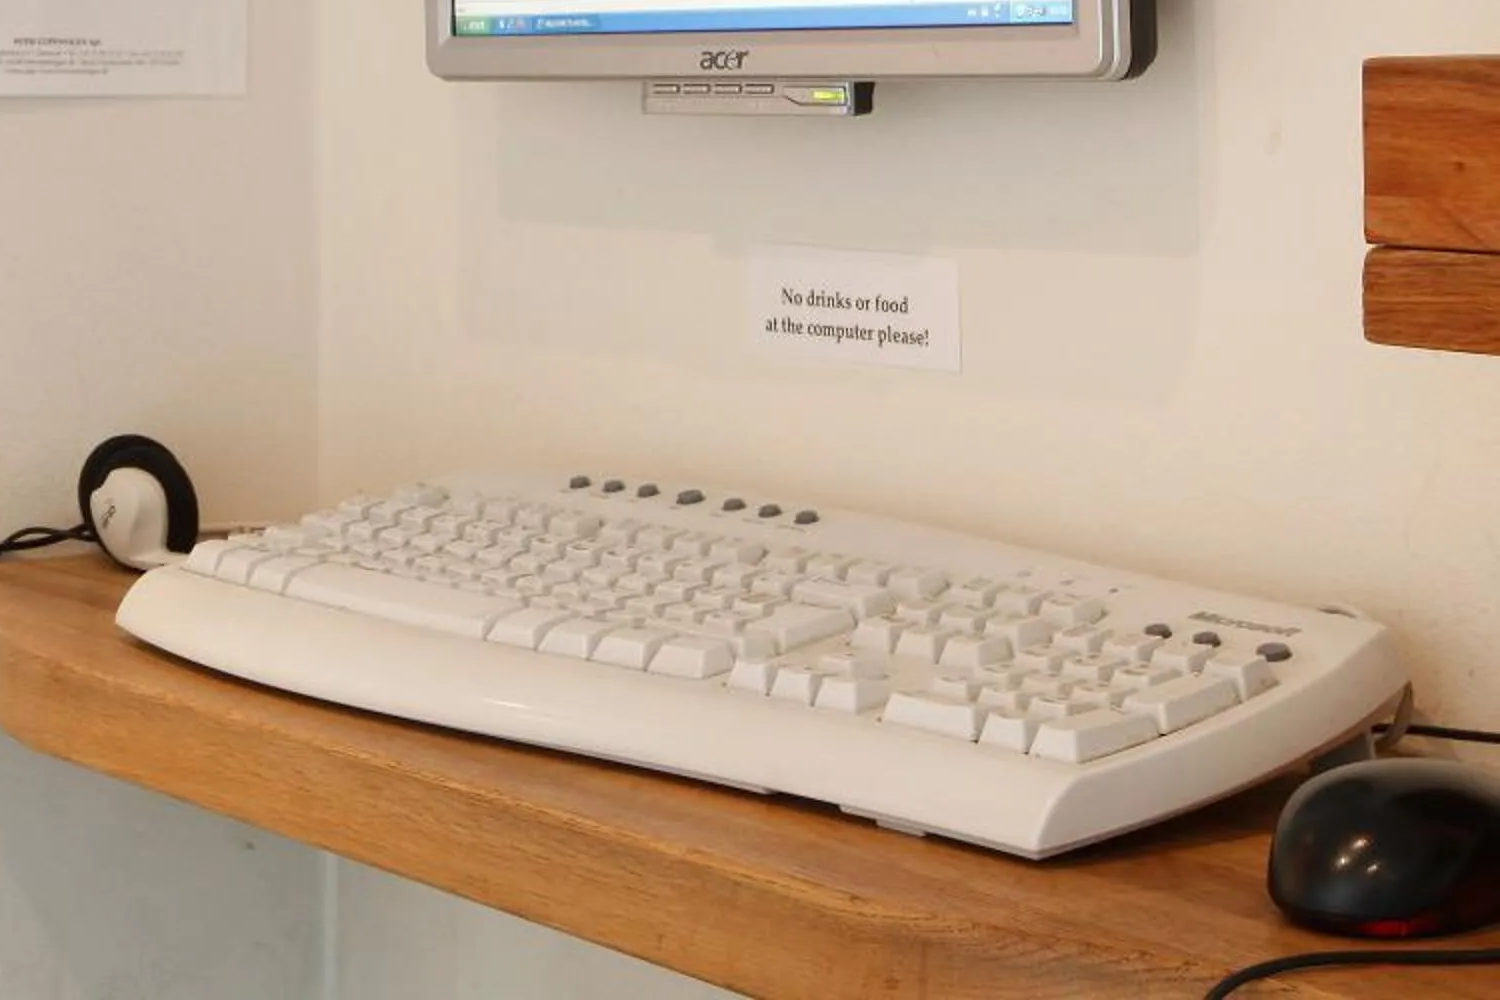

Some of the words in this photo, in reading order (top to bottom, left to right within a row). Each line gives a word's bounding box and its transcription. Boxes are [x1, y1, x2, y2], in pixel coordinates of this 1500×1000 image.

[700, 50, 750, 70] acer
[781, 286, 804, 306] No
[806, 288, 851, 311] drinks
[855, 297, 872, 312] or
[875, 294, 910, 315] food
[765, 317, 779, 333] at
[781, 317, 804, 336] the
[807, 321, 875, 344] computer
[878, 325, 931, 348] please!
